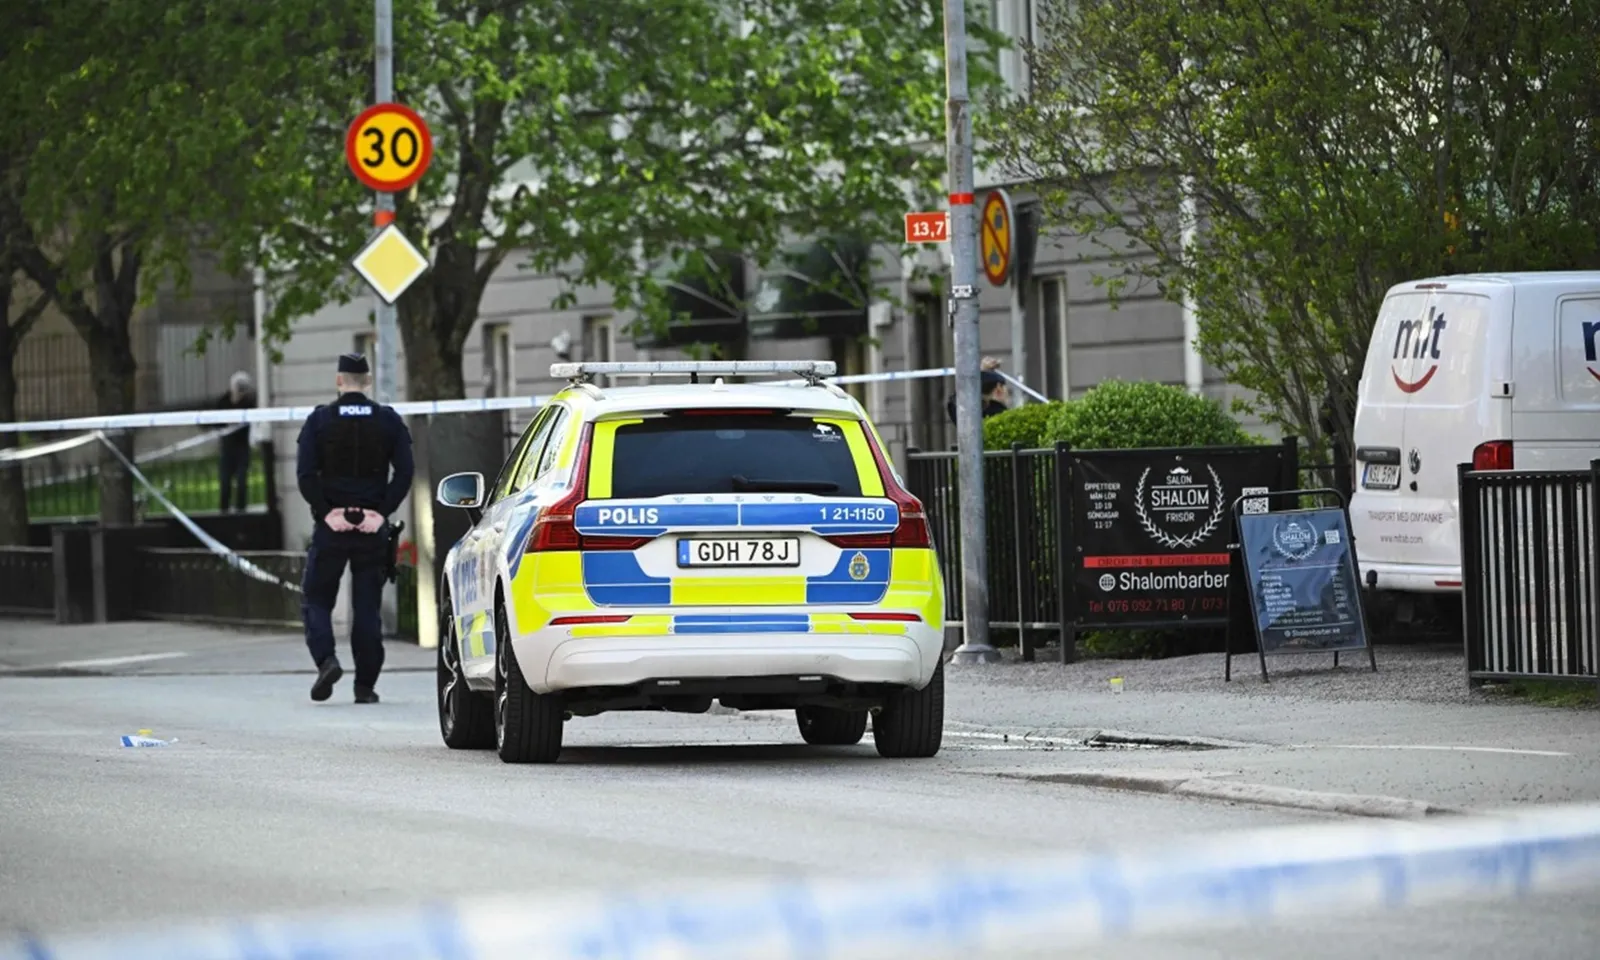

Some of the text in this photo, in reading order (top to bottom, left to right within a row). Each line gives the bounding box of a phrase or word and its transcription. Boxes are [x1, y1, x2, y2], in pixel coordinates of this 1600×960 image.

[362, 127, 418, 168] 30
[913, 221, 944, 237] 13,7
[339, 404, 372, 415] POLIS
[1166, 475, 1192, 485] SALON
[1151, 489, 1210, 507] SHALOM
[598, 507, 659, 525] POLIS
[833, 507, 886, 522] 21-1150
[1166, 512, 1195, 522] FRISÖR
[697, 541, 789, 562] GDH 78J
[1119, 571, 1229, 591] Shalombarber
[1089, 600, 1104, 613] Tel
[1107, 600, 1129, 612] 076
